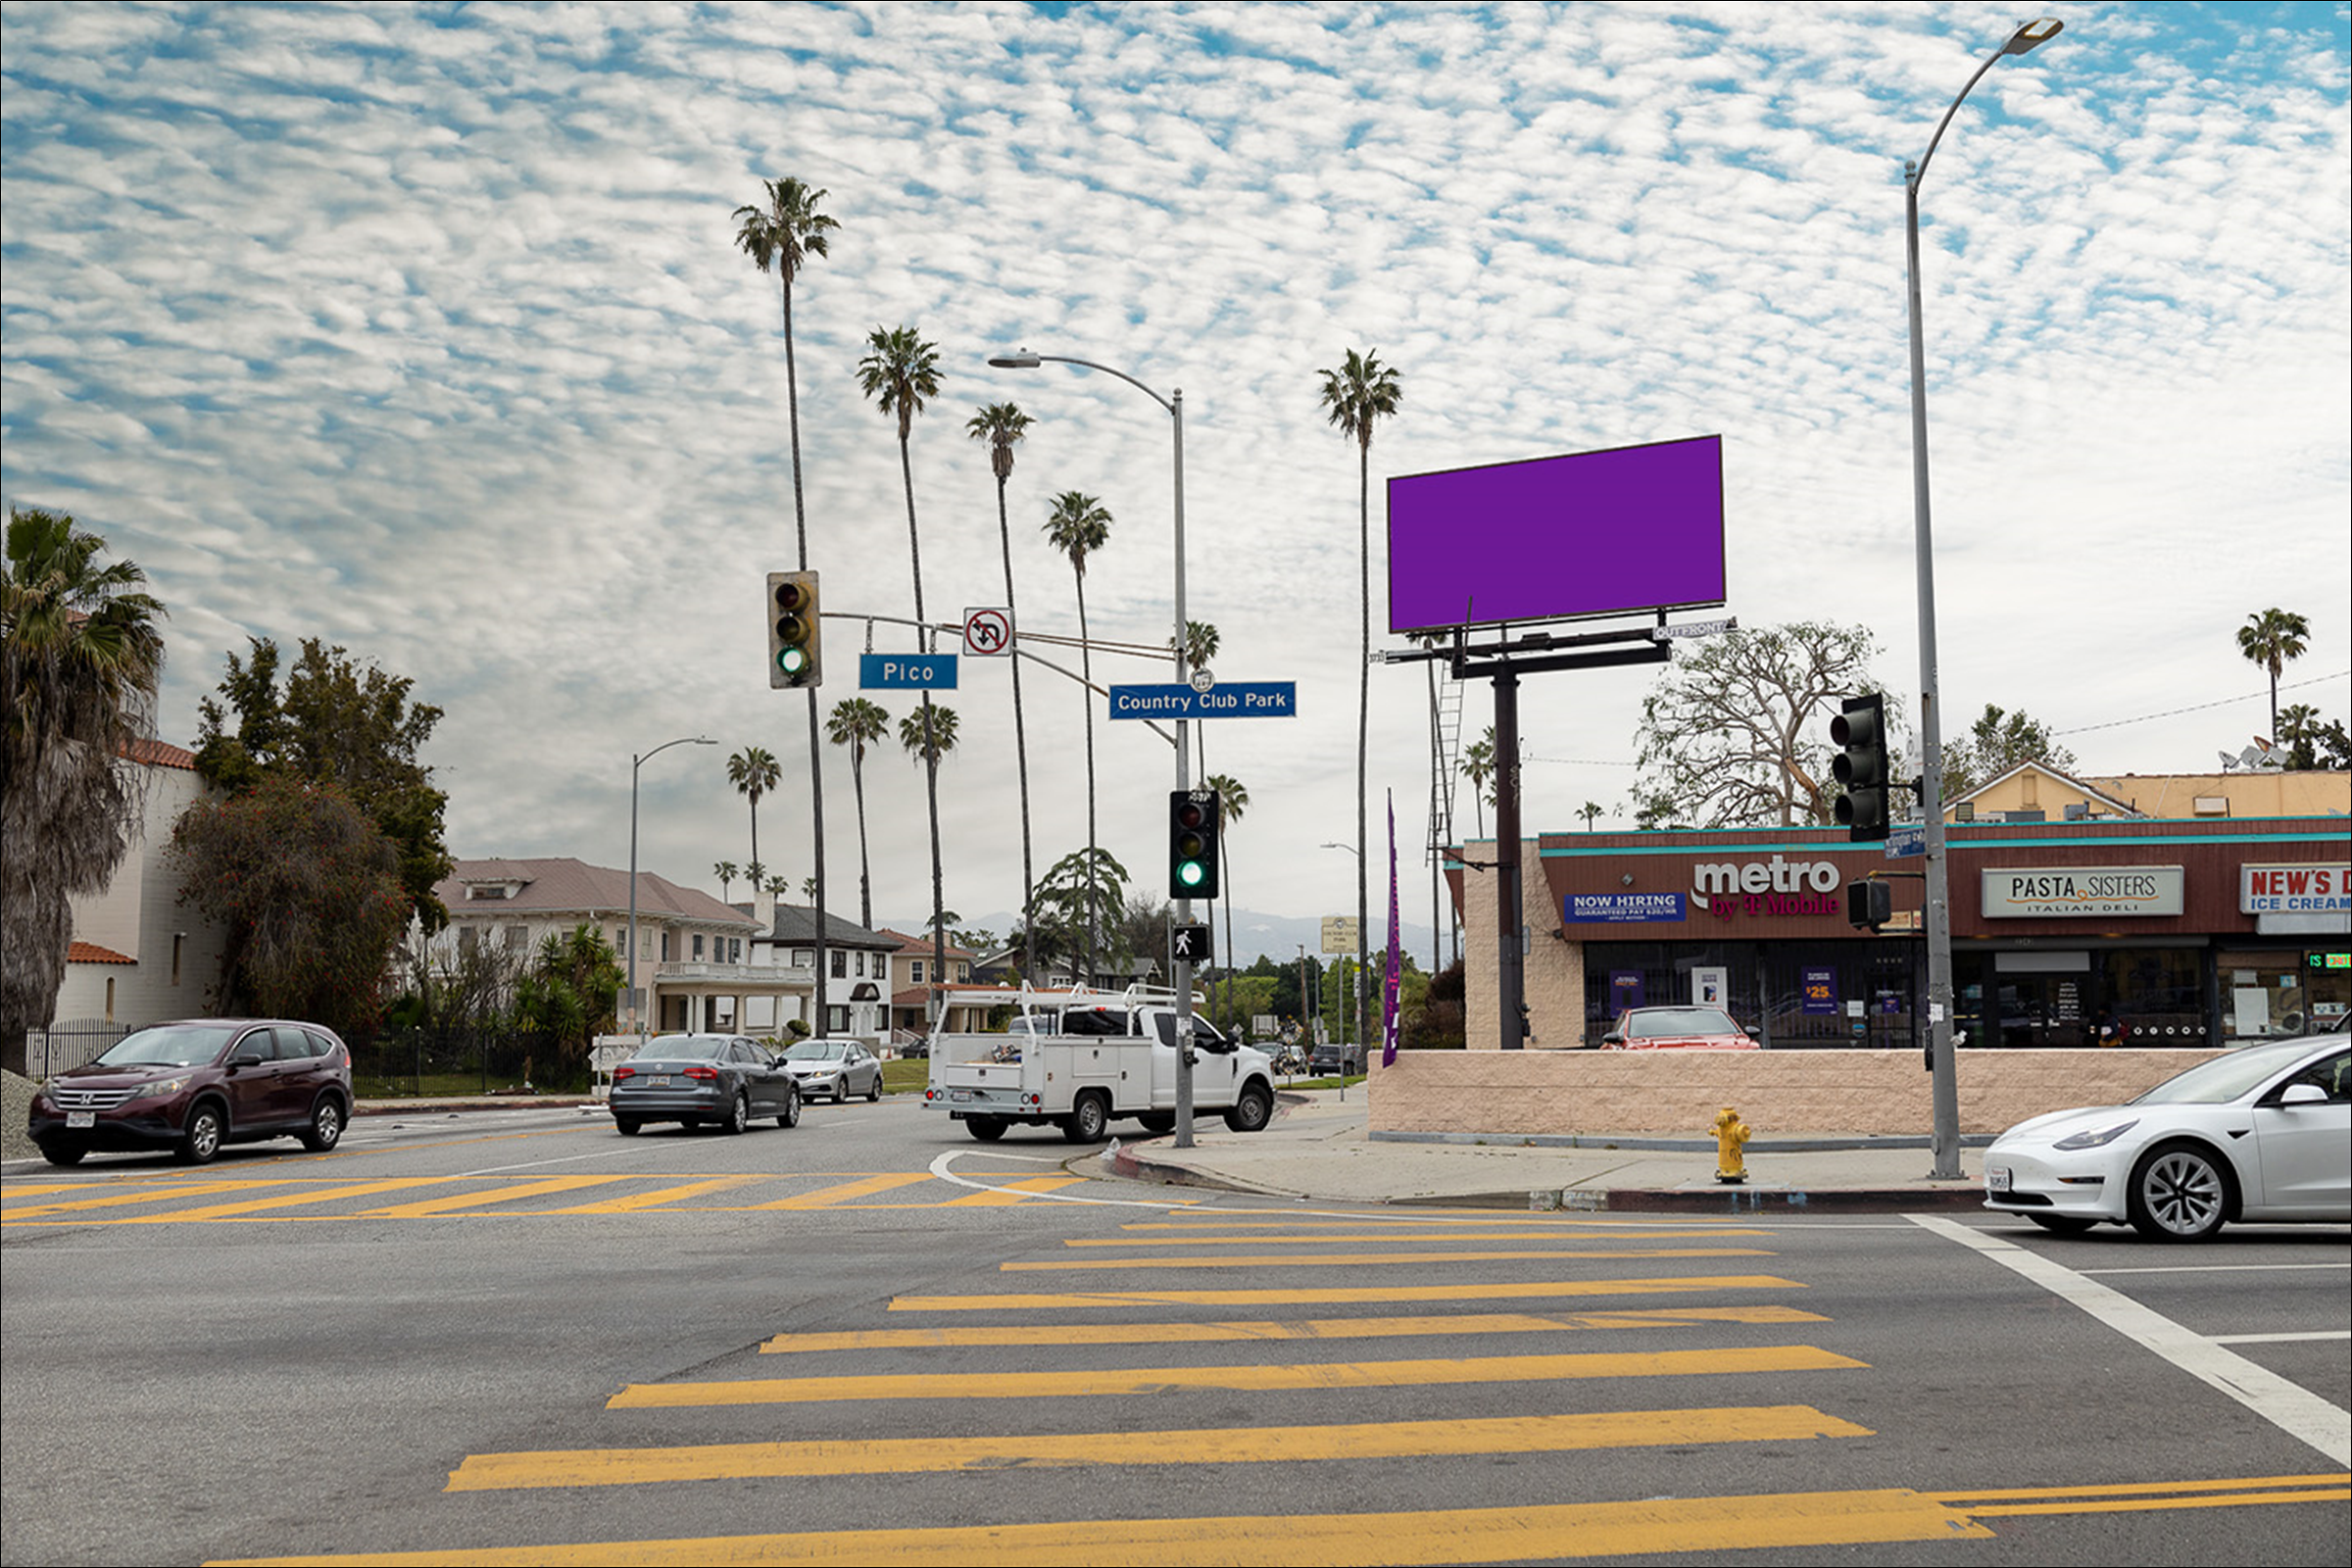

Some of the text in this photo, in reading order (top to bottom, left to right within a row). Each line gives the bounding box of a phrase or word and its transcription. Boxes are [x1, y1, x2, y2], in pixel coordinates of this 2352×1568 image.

[1655, 620, 1725, 638] OUTFRONT
[884, 662, 933, 681] Pico
[1118, 693, 1286, 711] Country Club Park
[1692, 855, 1840, 896] metro
[2251, 869, 2331, 896] NEW'S
[2012, 875, 2156, 898] PASTA SISTERS
[1575, 895, 1676, 907] NOW HIRING
[1712, 895, 1738, 921] by
[1766, 893, 1840, 915] Mobile
[2103, 904, 2138, 912] DELI
[2251, 897, 2351, 909] ICE CREAM
[1574, 907, 1627, 916] GUARANTEED
